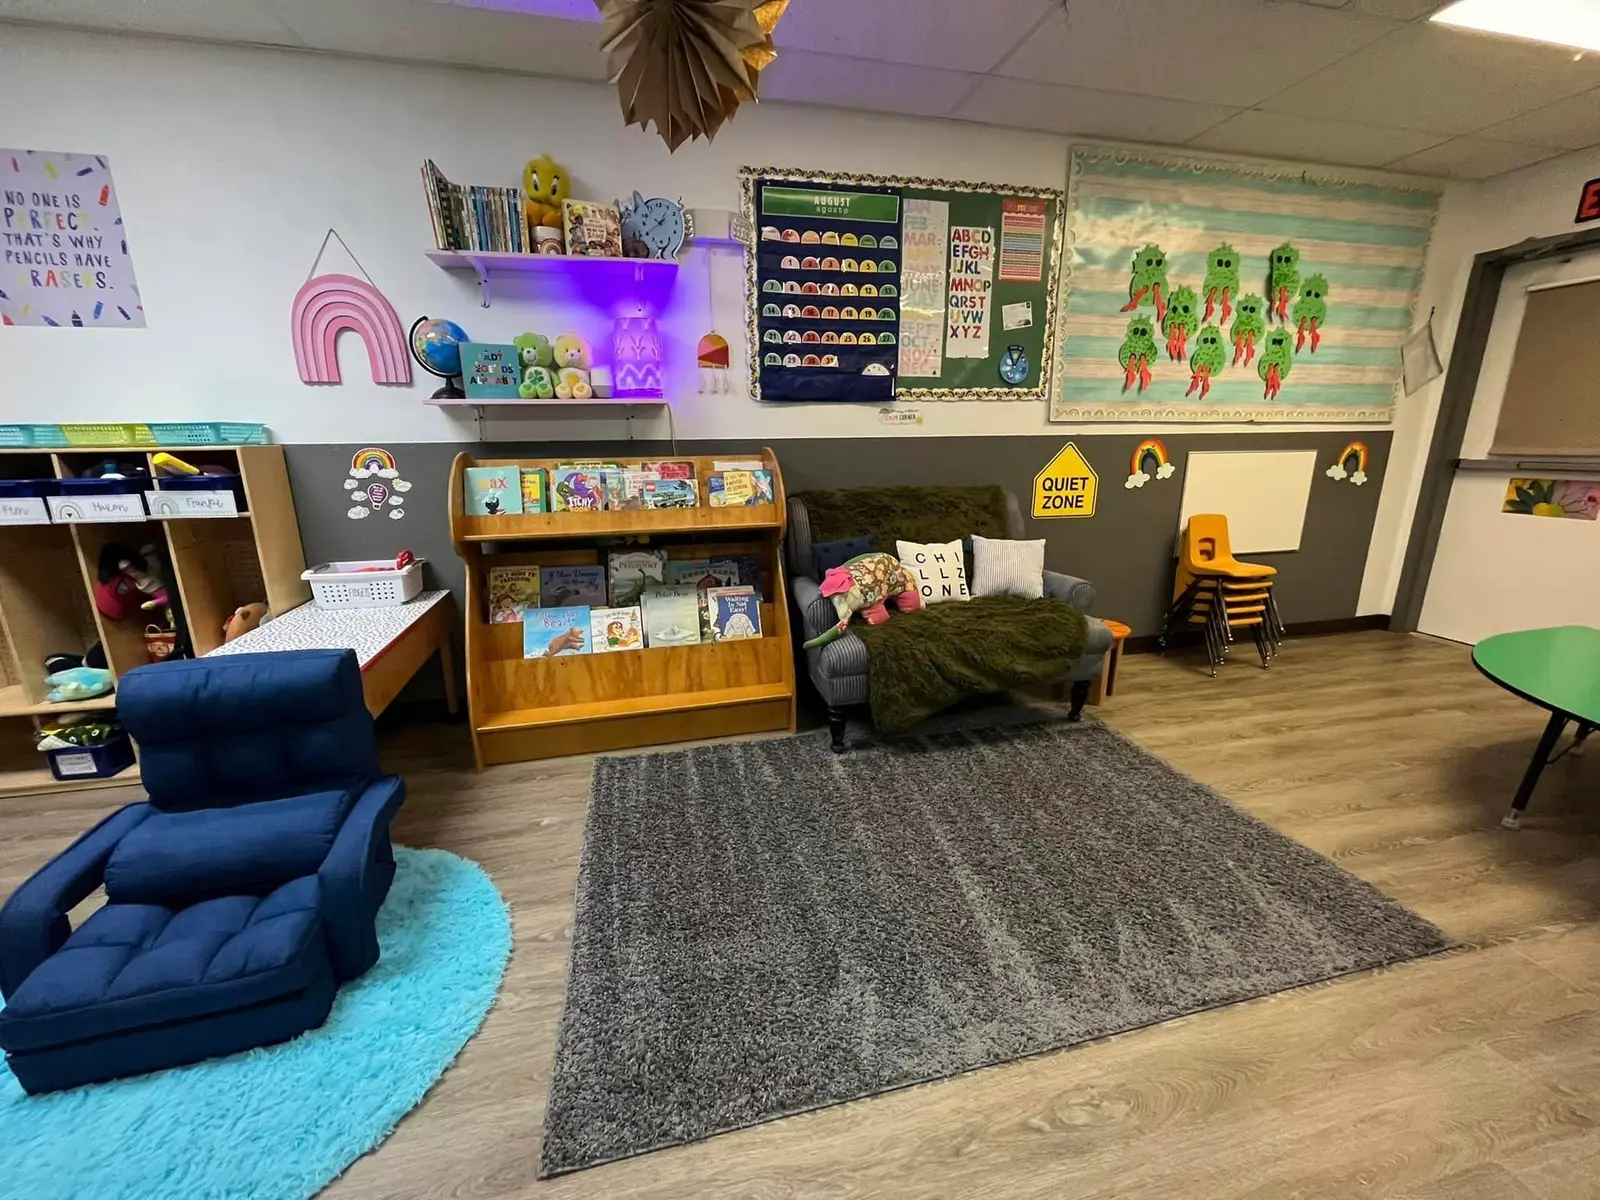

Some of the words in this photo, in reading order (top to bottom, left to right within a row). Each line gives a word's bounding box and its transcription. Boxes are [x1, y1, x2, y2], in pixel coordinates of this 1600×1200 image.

[5, 190, 25, 206] NO
[32, 192, 60, 208] ONE
[65, 194, 81, 208] IS
[814, 195, 851, 207] AUGUST
[2, 232, 61, 248] THAT'S
[68, 235, 103, 249] WHY
[904, 232, 936, 247] MAR
[5, 249, 68, 266] PENCILS
[74, 253, 112, 268] HAVE
[18, 269, 114, 289] RASES.
[470, 376, 517, 385] ALPABT
[1042, 477, 1089, 492] QUIET
[567, 496, 594, 508] ITCHY
[1042, 495, 1084, 510] ZONE
